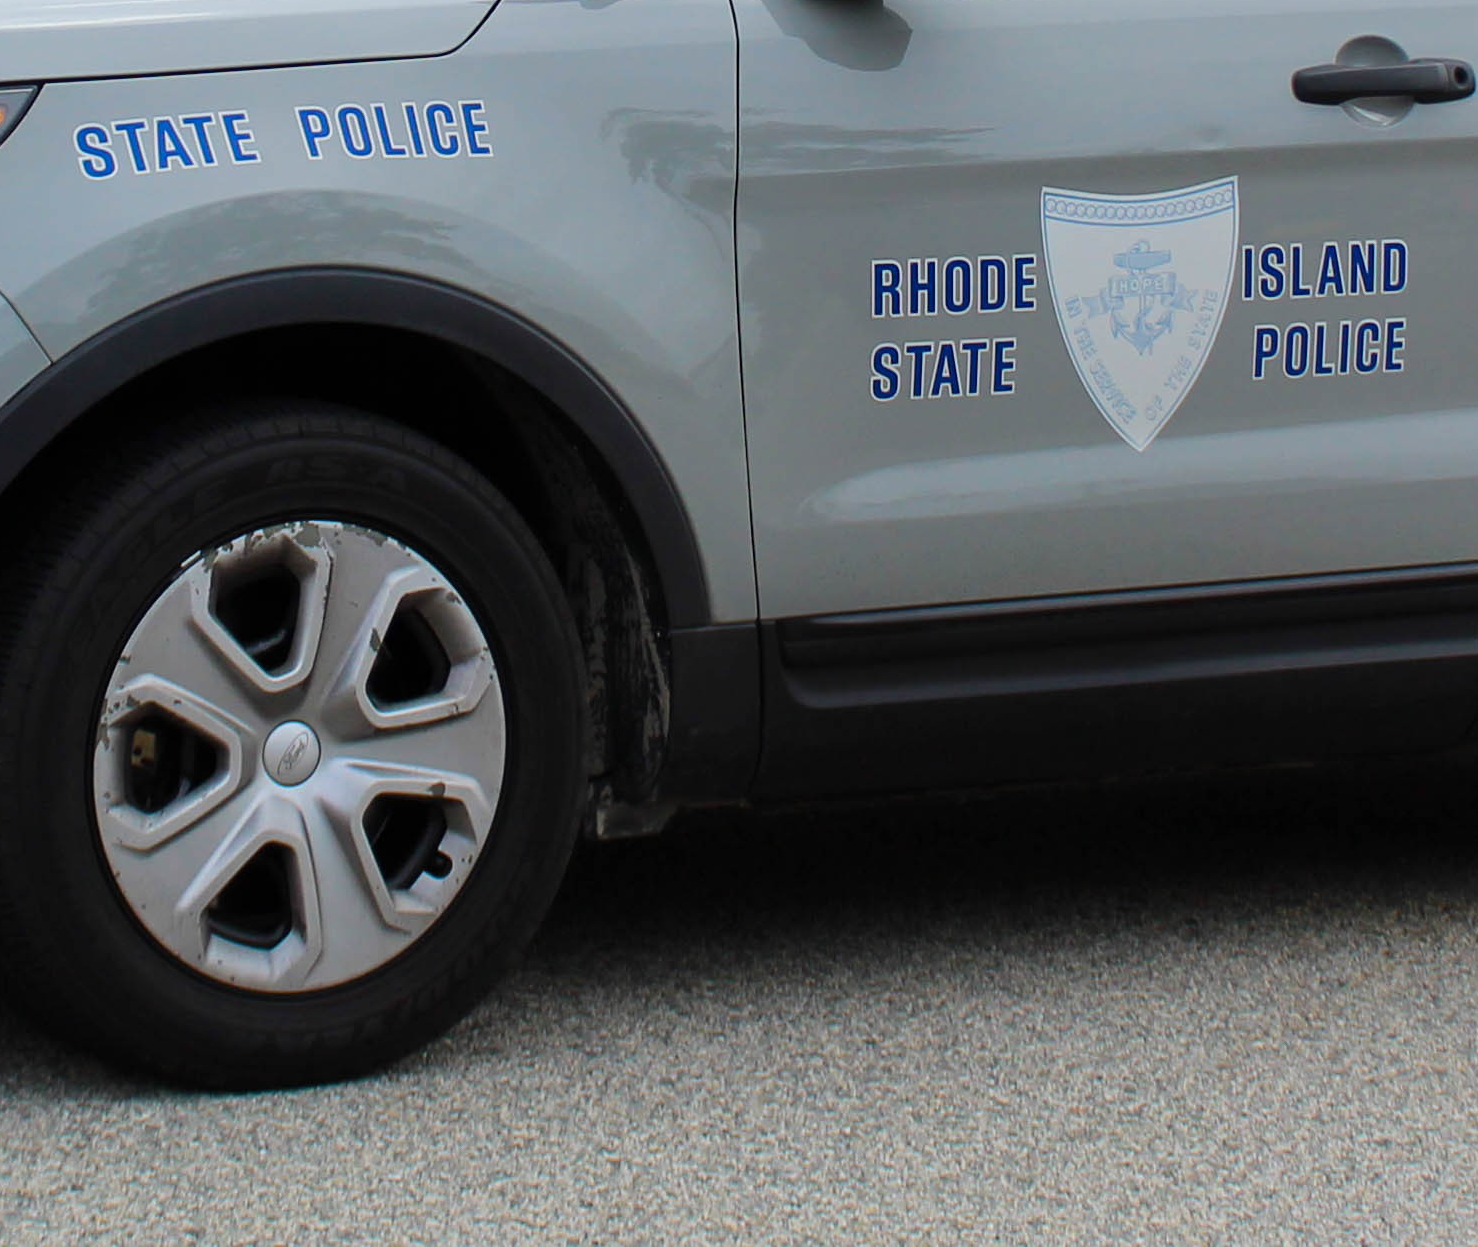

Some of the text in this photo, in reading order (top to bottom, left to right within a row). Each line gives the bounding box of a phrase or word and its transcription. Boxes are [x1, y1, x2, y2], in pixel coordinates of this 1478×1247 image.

[73, 99, 494, 181] STATE POLICE
[871, 239, 1408, 319] RHODE ISLAND
[1119, 276, 1163, 293] HOPE
[871, 317, 1407, 402] STATE POLICE
